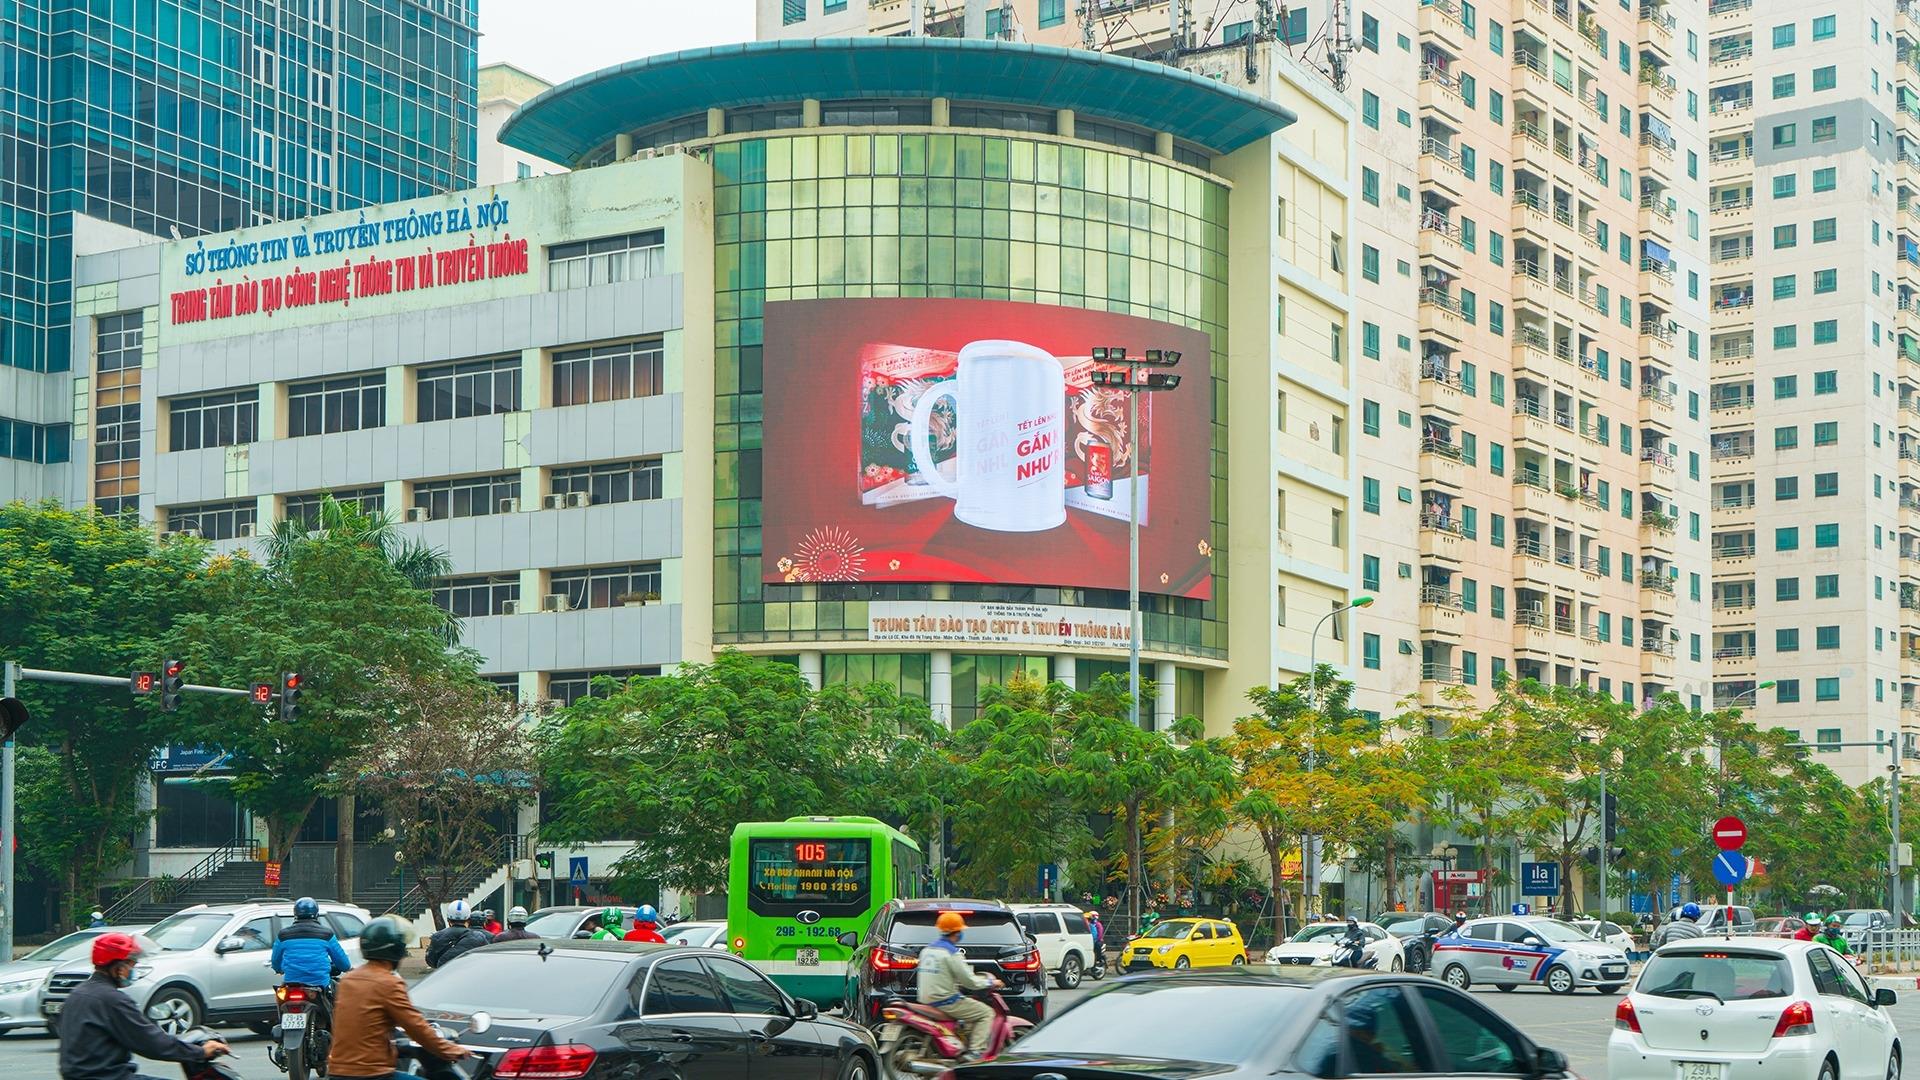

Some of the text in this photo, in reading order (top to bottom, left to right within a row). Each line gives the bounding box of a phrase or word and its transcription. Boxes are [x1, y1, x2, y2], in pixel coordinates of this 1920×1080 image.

[186, 194, 509, 276] SỞ THÔNG TIN VÀ TRUYỀN THÔNG HÀ NỘI
[170, 233, 528, 325] TRUNG TÂM ĐÀO TẠO CÔNG NGHỆ THÔNG TIN VÀ TRUYỀN THÔNG
[1017, 431, 1051, 457] GẮN
[1017, 451, 1053, 481] NHƯ
[872, 617, 910, 632] TRUNG
[913, 614, 937, 632] TÂM
[939, 614, 963, 633] ĐÀO
[966, 618, 987, 636] TẠO
[990, 619, 1019, 634] CNTT
[1022, 620, 1030, 635] &
[1032, 616, 1072, 636] TRUYỀN
[1074, 620, 1108, 638] THÔNG
[1110, 622, 1123, 640] HÀ
[151, 760, 167, 769] JFC
[796, 844, 826, 861] 105
[824, 866, 836, 877] HÀ
[837, 867, 853, 880] NỘI
[1532, 864, 1548, 879] ila
[800, 881, 827, 891] 1900
[831, 882, 858, 891] 1296
[776, 926, 795, 937] 29B
[806, 926, 841, 937] 192.68
[1692, 1062, 1711, 1075] 29A
